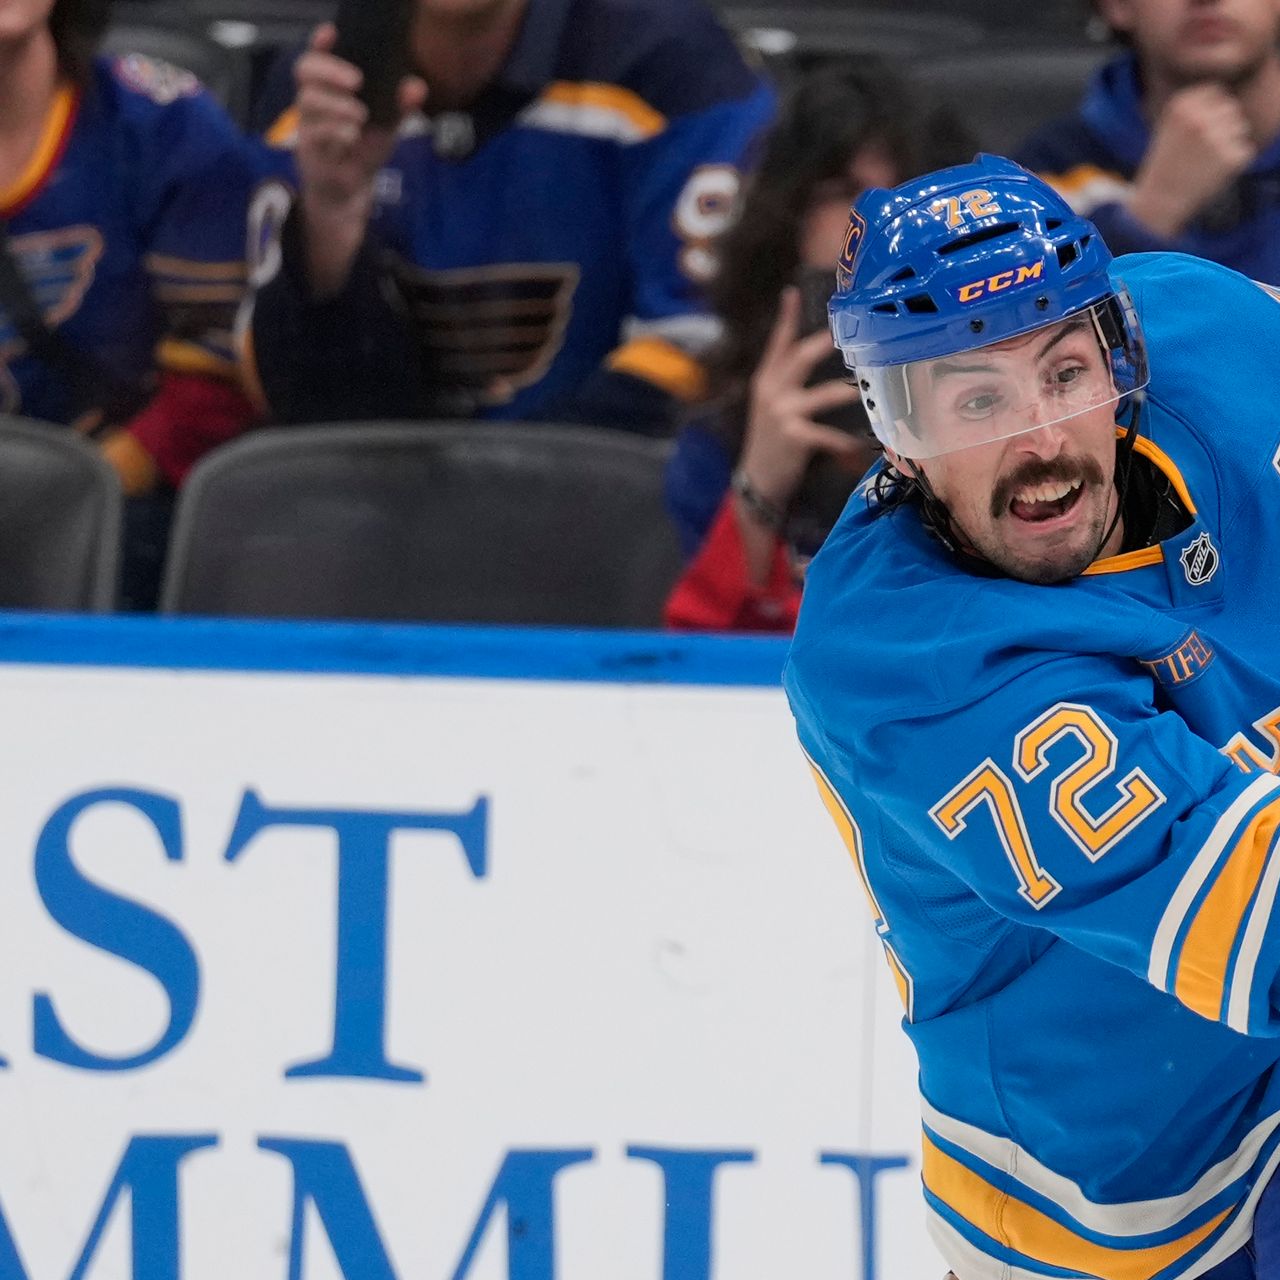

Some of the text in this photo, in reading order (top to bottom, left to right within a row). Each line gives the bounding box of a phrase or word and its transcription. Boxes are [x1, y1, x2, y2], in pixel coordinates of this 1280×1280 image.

[927, 188, 1003, 230] 72
[958, 260, 1044, 303] CCM
[1138, 630, 1213, 685] TIFEL
[927, 701, 1168, 911] 72
[0, 783, 492, 1086] ST
